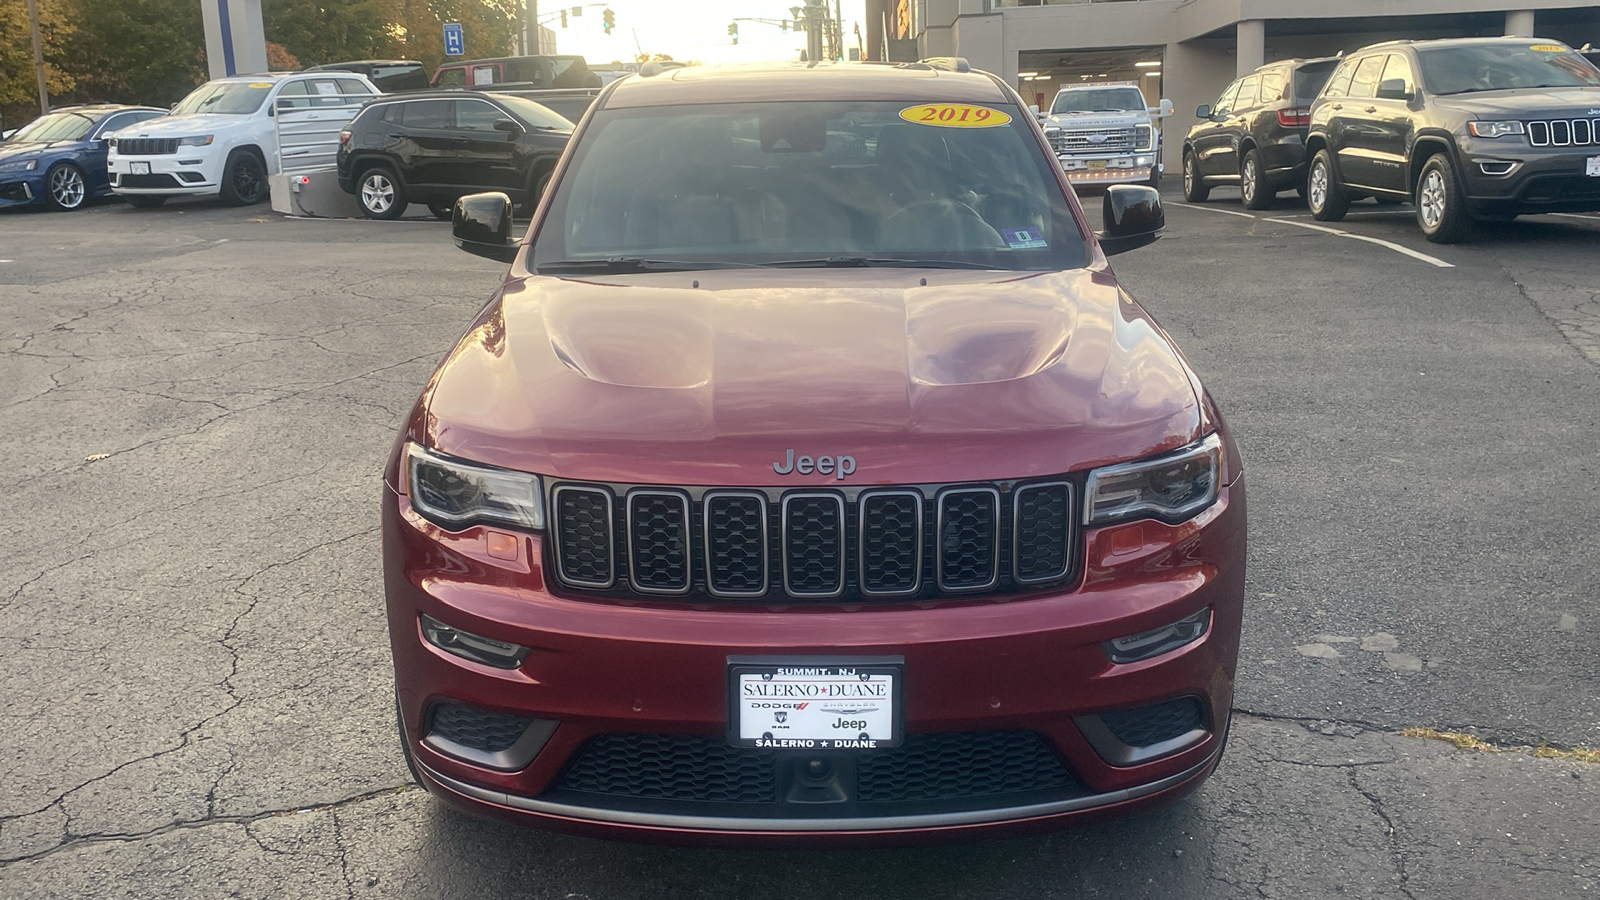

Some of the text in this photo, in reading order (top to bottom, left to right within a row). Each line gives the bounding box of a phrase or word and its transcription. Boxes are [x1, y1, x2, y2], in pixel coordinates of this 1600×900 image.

[448, 31, 459, 46] H
[920, 107, 991, 122] 2019
[1019, 232, 1027, 240] 8
[772, 448, 857, 481] Jeep
[777, 668, 856, 676] SUMMIT, NJ
[744, 683, 887, 696] SALERNO DUANE
[832, 717, 867, 731] Jeep
[755, 739, 877, 748] SALERNO DUANE
